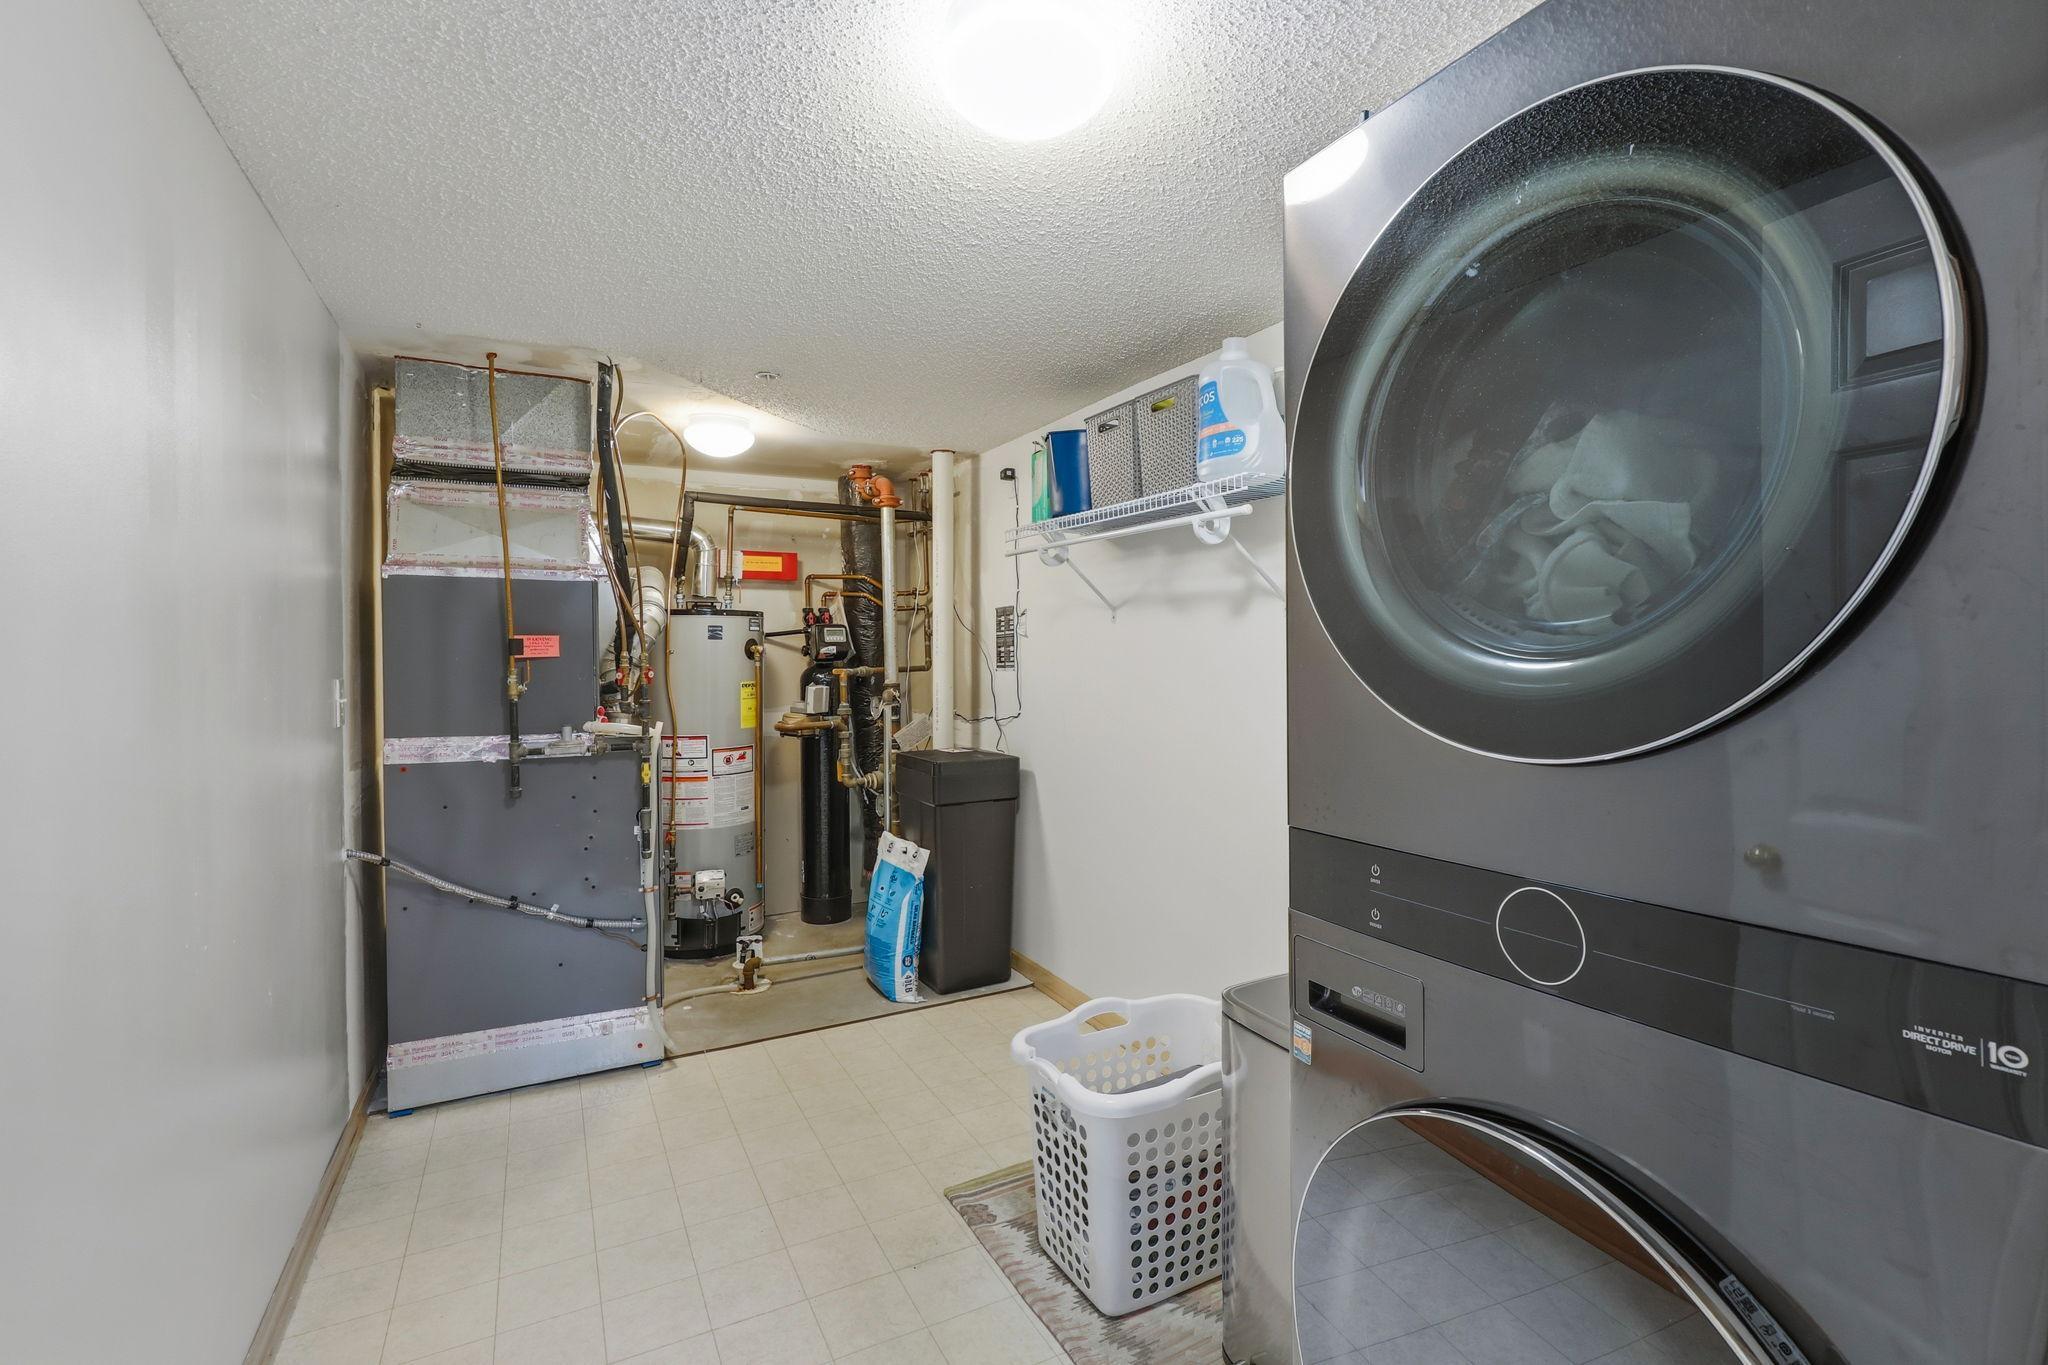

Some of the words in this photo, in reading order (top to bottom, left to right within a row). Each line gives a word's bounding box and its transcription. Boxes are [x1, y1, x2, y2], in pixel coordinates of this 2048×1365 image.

[1902, 1029, 1941, 1046] DIRECT
[1942, 1039, 1977, 1056] DRIVE
[1913, 1024, 1965, 1042] INVERTER
[1925, 1044, 1953, 1056] MOTOR
[1987, 1041, 2030, 1069] 10
